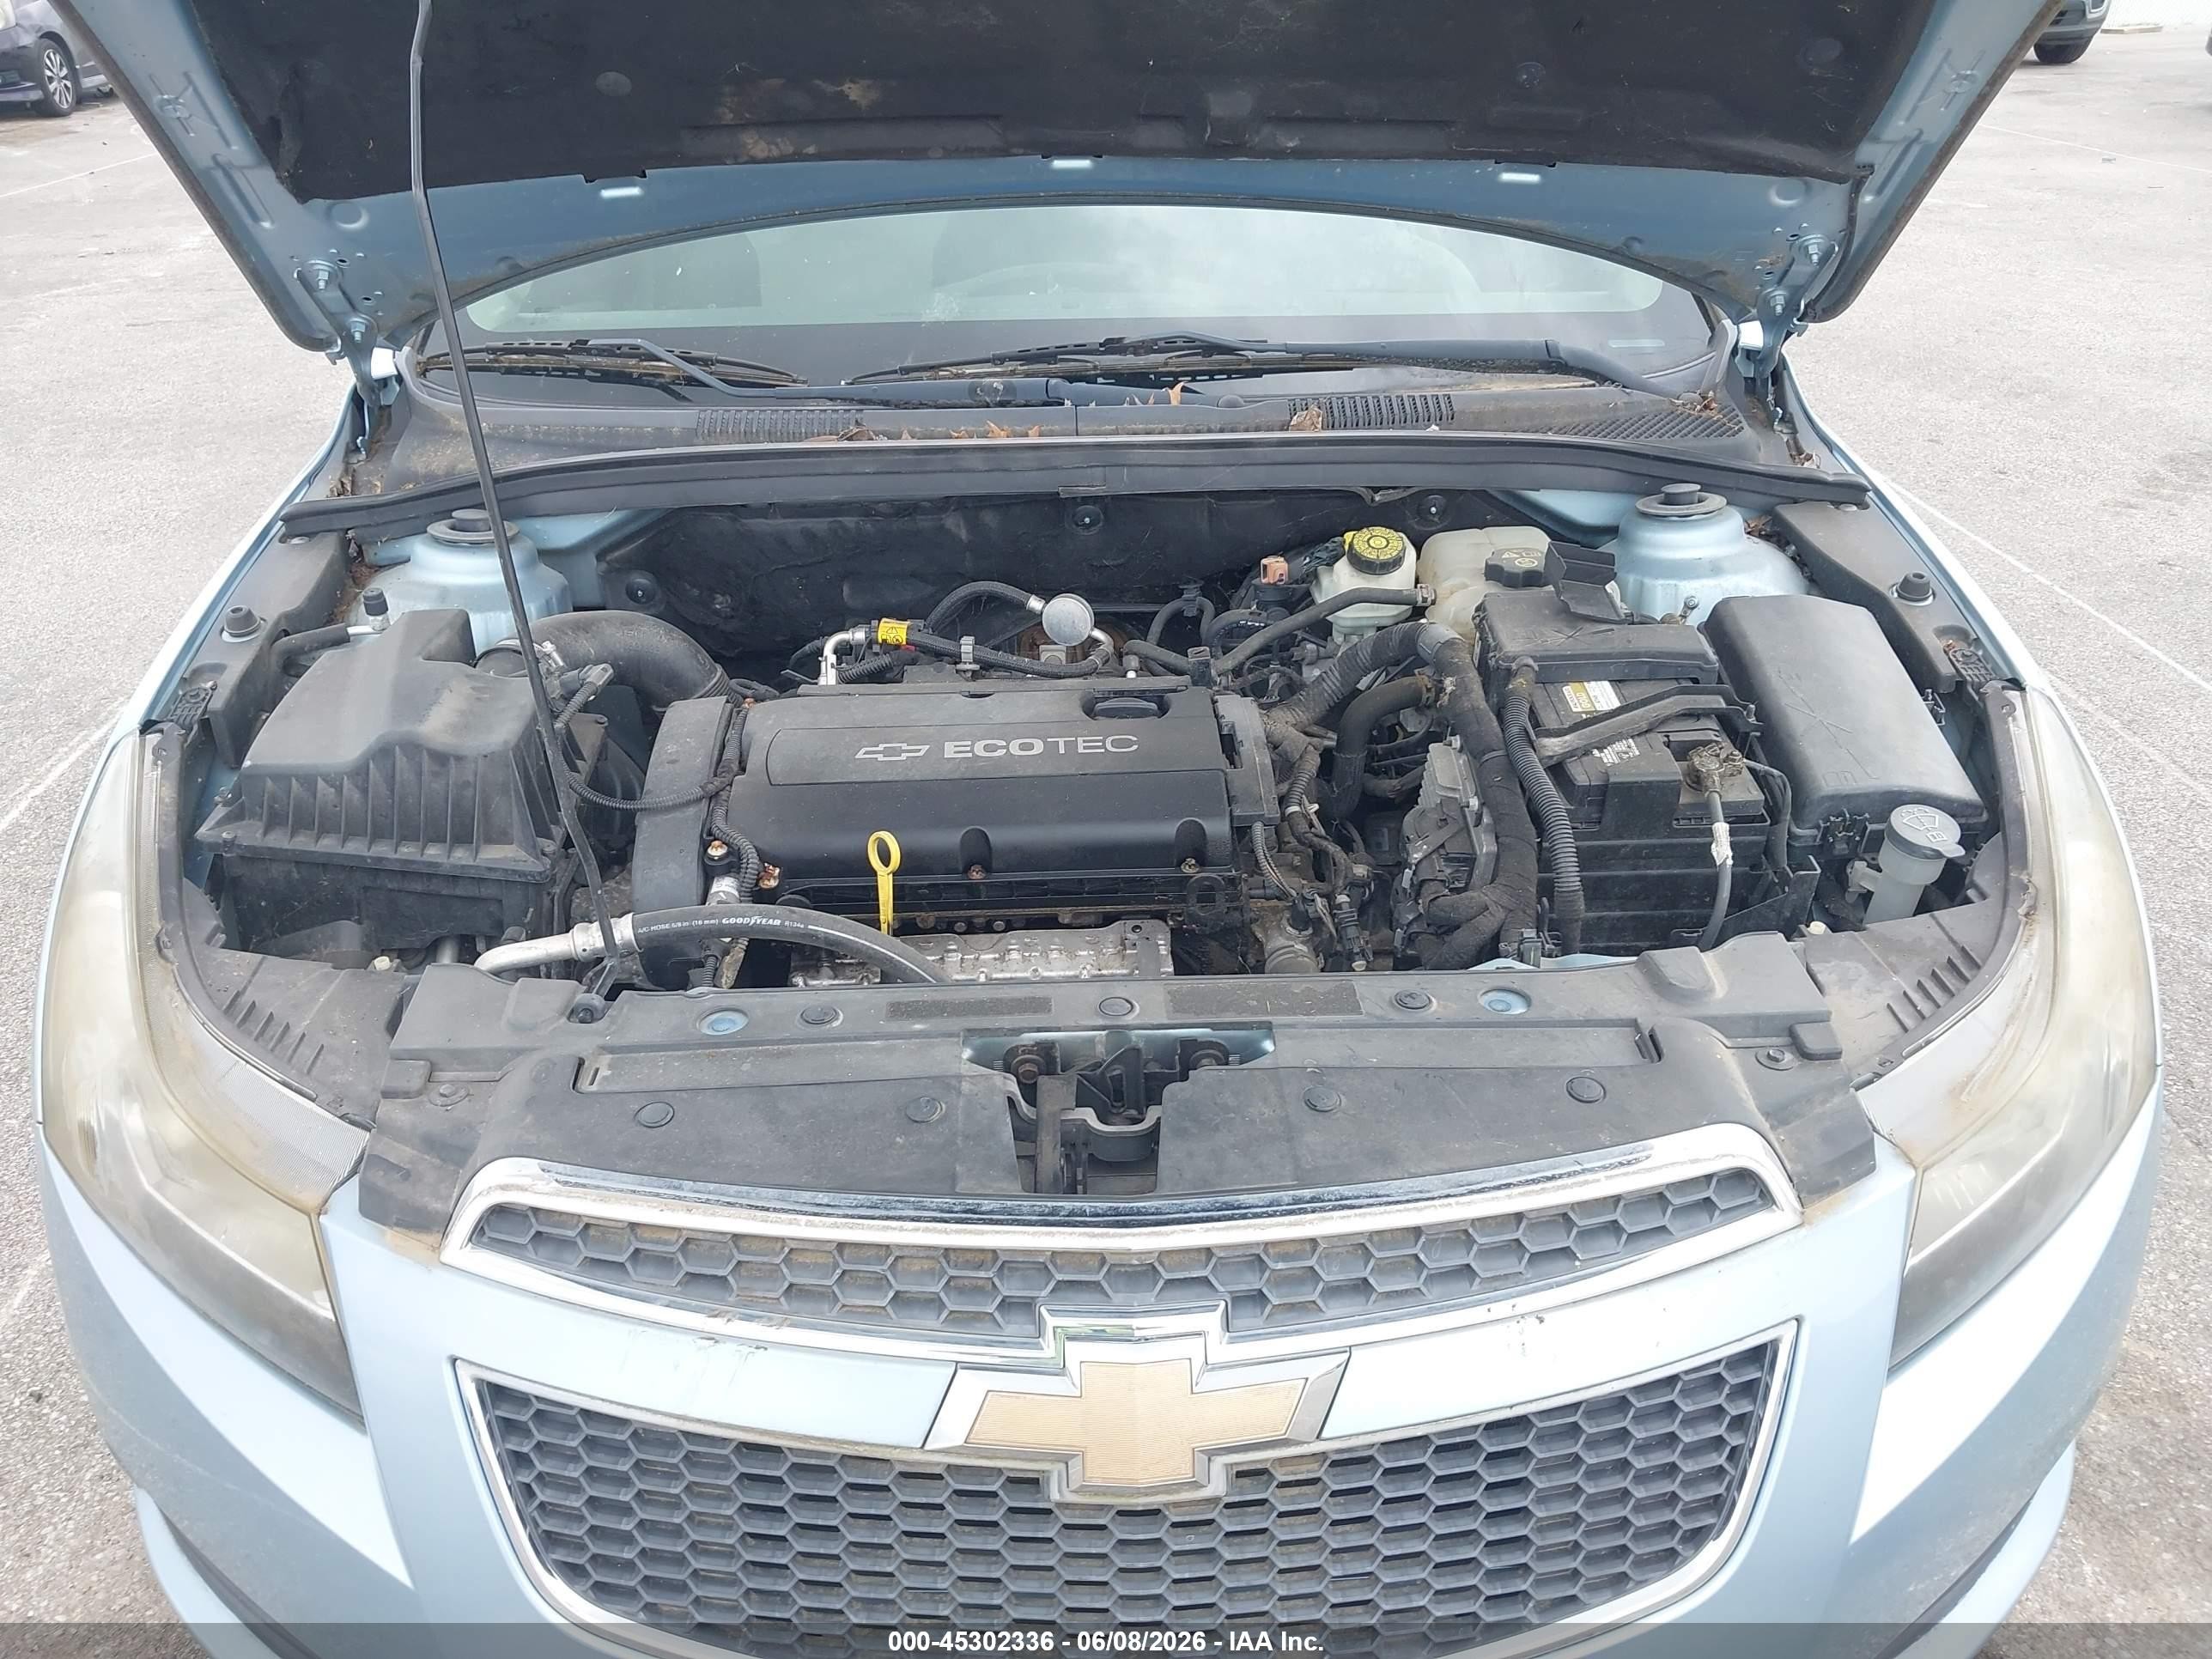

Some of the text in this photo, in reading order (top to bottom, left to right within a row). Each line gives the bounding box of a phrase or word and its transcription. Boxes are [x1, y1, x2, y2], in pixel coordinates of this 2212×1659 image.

[1576, 692, 1591, 708] GOLD
[944, 735, 1139, 758] ECOTEC
[721, 915, 781, 927] GOODYEAR
